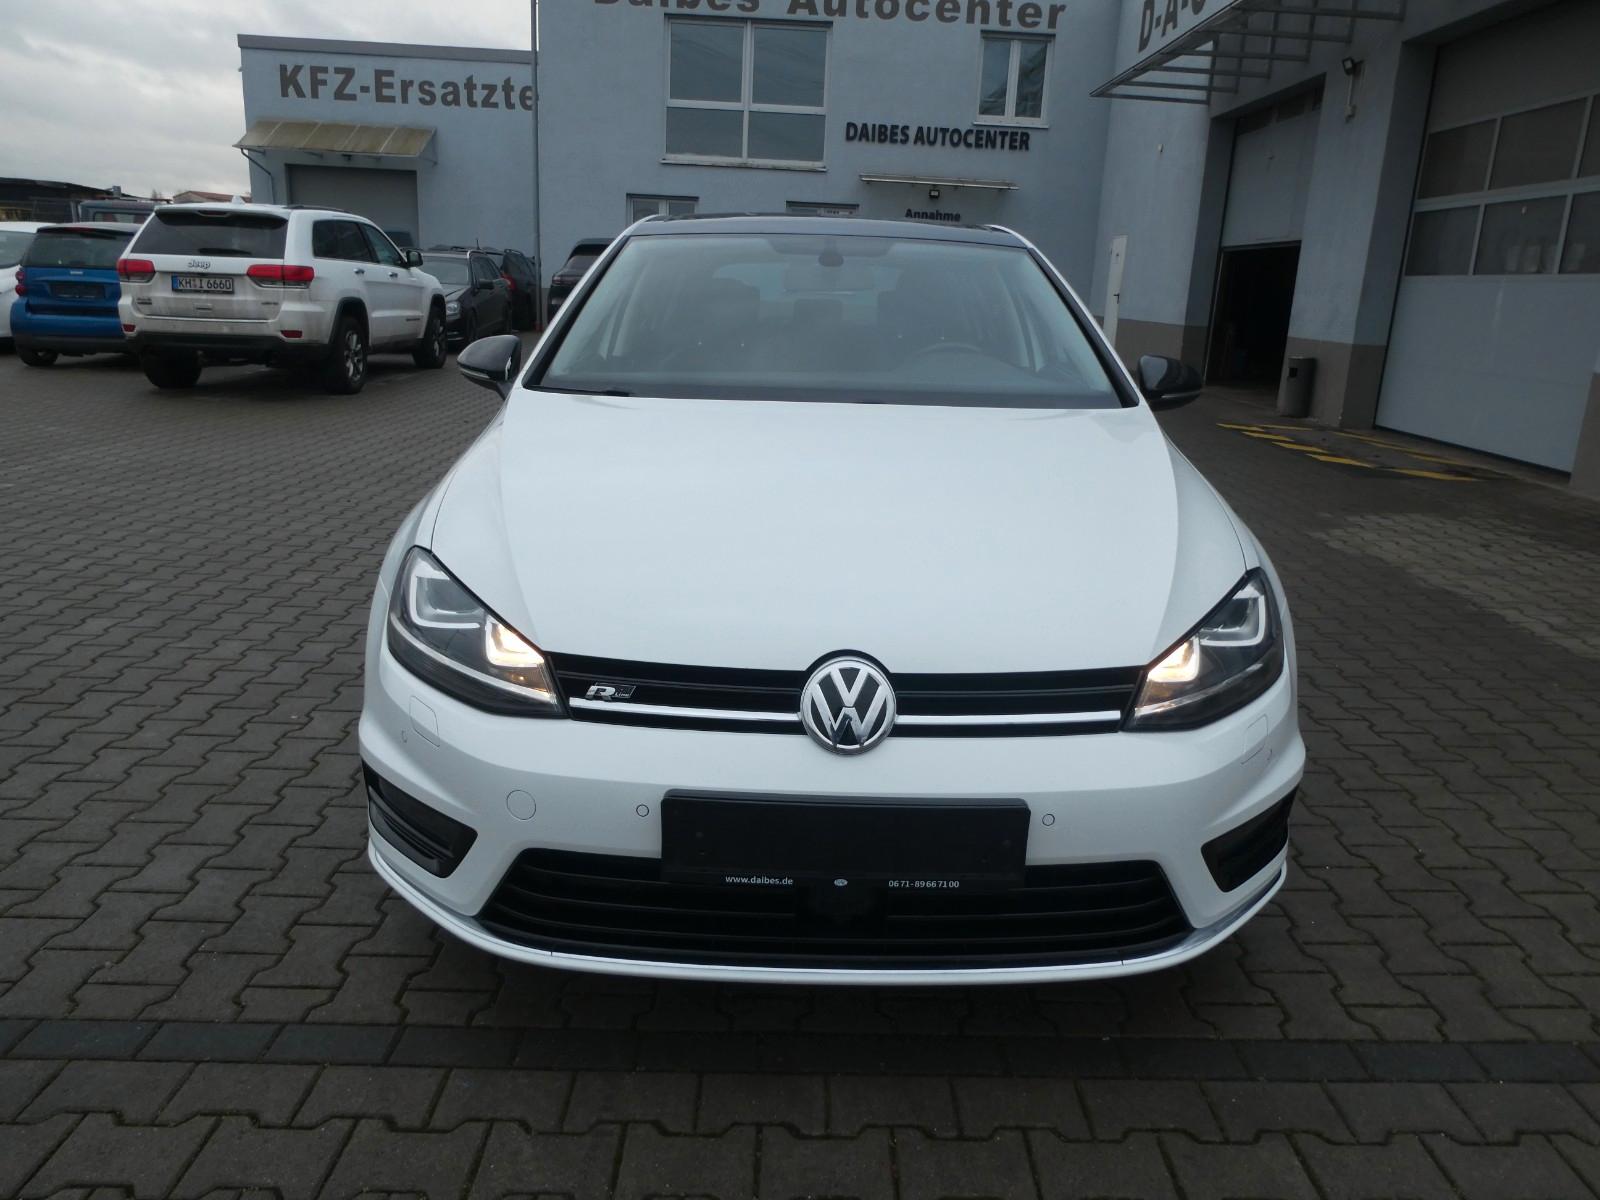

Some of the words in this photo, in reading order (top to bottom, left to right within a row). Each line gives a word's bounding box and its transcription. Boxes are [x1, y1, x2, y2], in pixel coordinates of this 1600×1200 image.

[845, 122, 910, 145] DAIBES
[913, 126, 1031, 151] AUTOCENTER
[905, 207, 961, 222] Annahme
[725, 875, 794, 886] www.daibes.de
